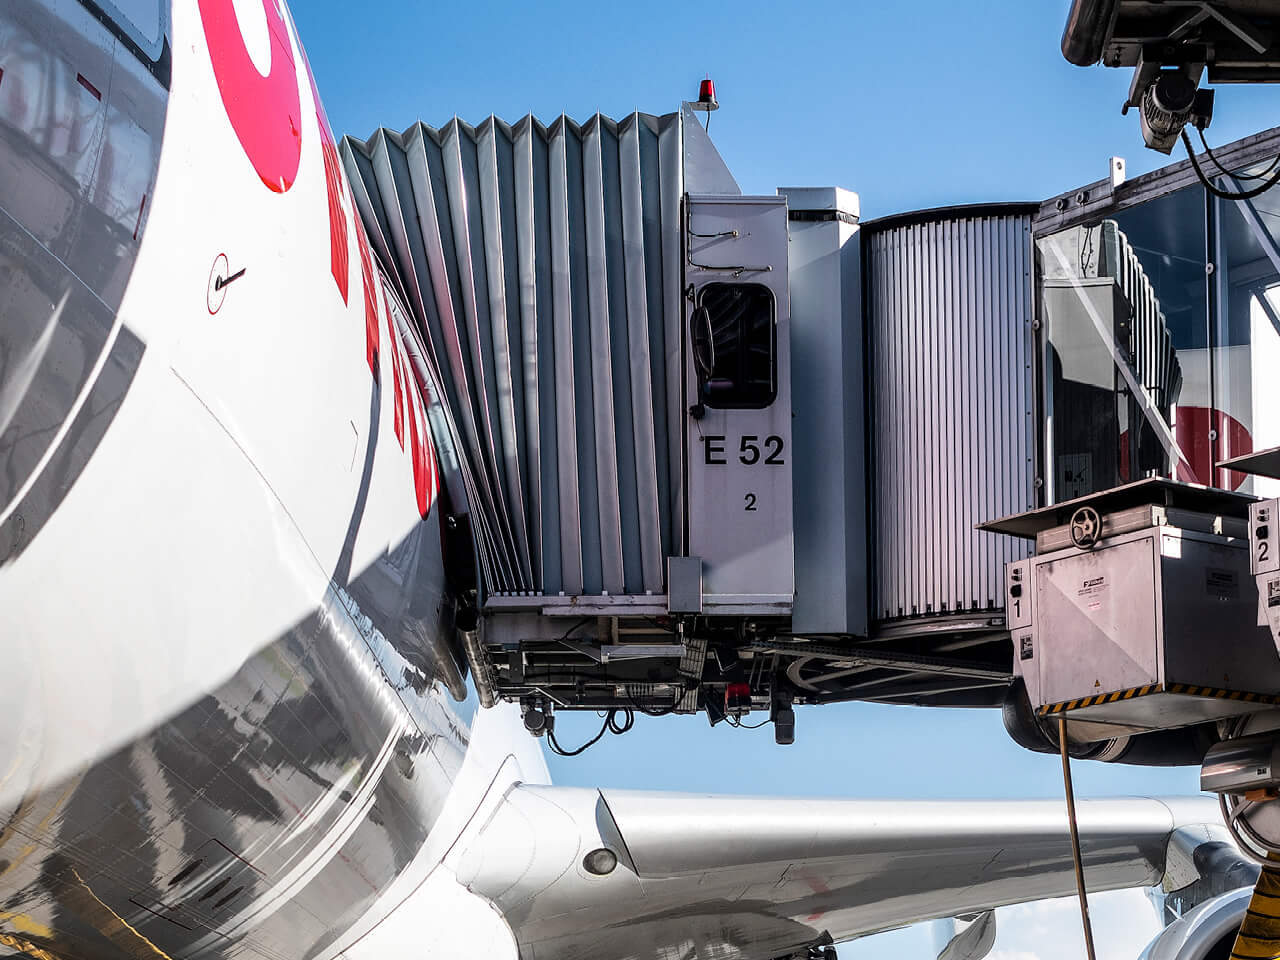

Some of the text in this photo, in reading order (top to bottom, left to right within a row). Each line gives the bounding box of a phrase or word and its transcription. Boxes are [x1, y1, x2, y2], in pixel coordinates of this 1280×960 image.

[704, 435, 785, 466] E 52
[744, 493, 757, 511] 2
[1258, 541, 1269, 562] 2
[1013, 600, 1020, 618] 1
